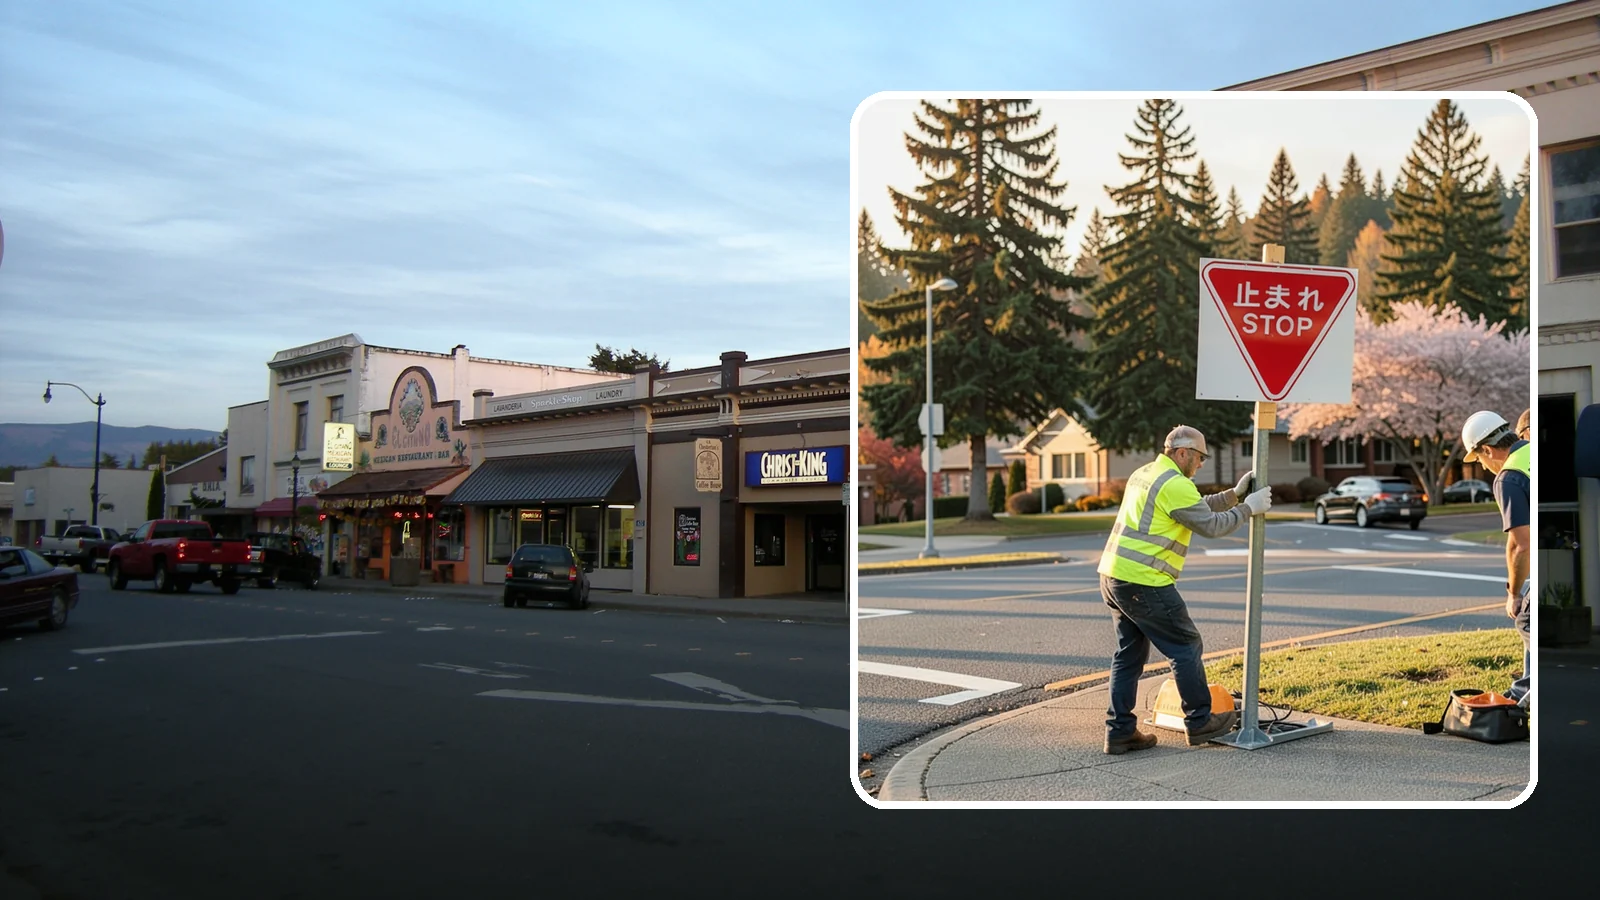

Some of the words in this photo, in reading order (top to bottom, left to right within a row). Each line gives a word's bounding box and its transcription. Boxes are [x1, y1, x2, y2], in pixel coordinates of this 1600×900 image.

[1233, 281, 1324, 312] 止まれ
[1242, 313, 1313, 336] STOP
[493, 402, 522, 413] LAVANDERIA
[530, 398, 561, 409] Sparkle
[562, 395, 582, 405] Shop
[595, 389, 623, 400] LAUNDRY
[392, 425, 401, 449] EL
[373, 455, 395, 464] MEXICAN
[398, 452, 433, 462] RESTAURANT
[438, 450, 450, 459] BAR
[761, 452, 797, 478] CHRIST
[799, 450, 827, 476] KING
[696, 481, 709, 489] Coffee
